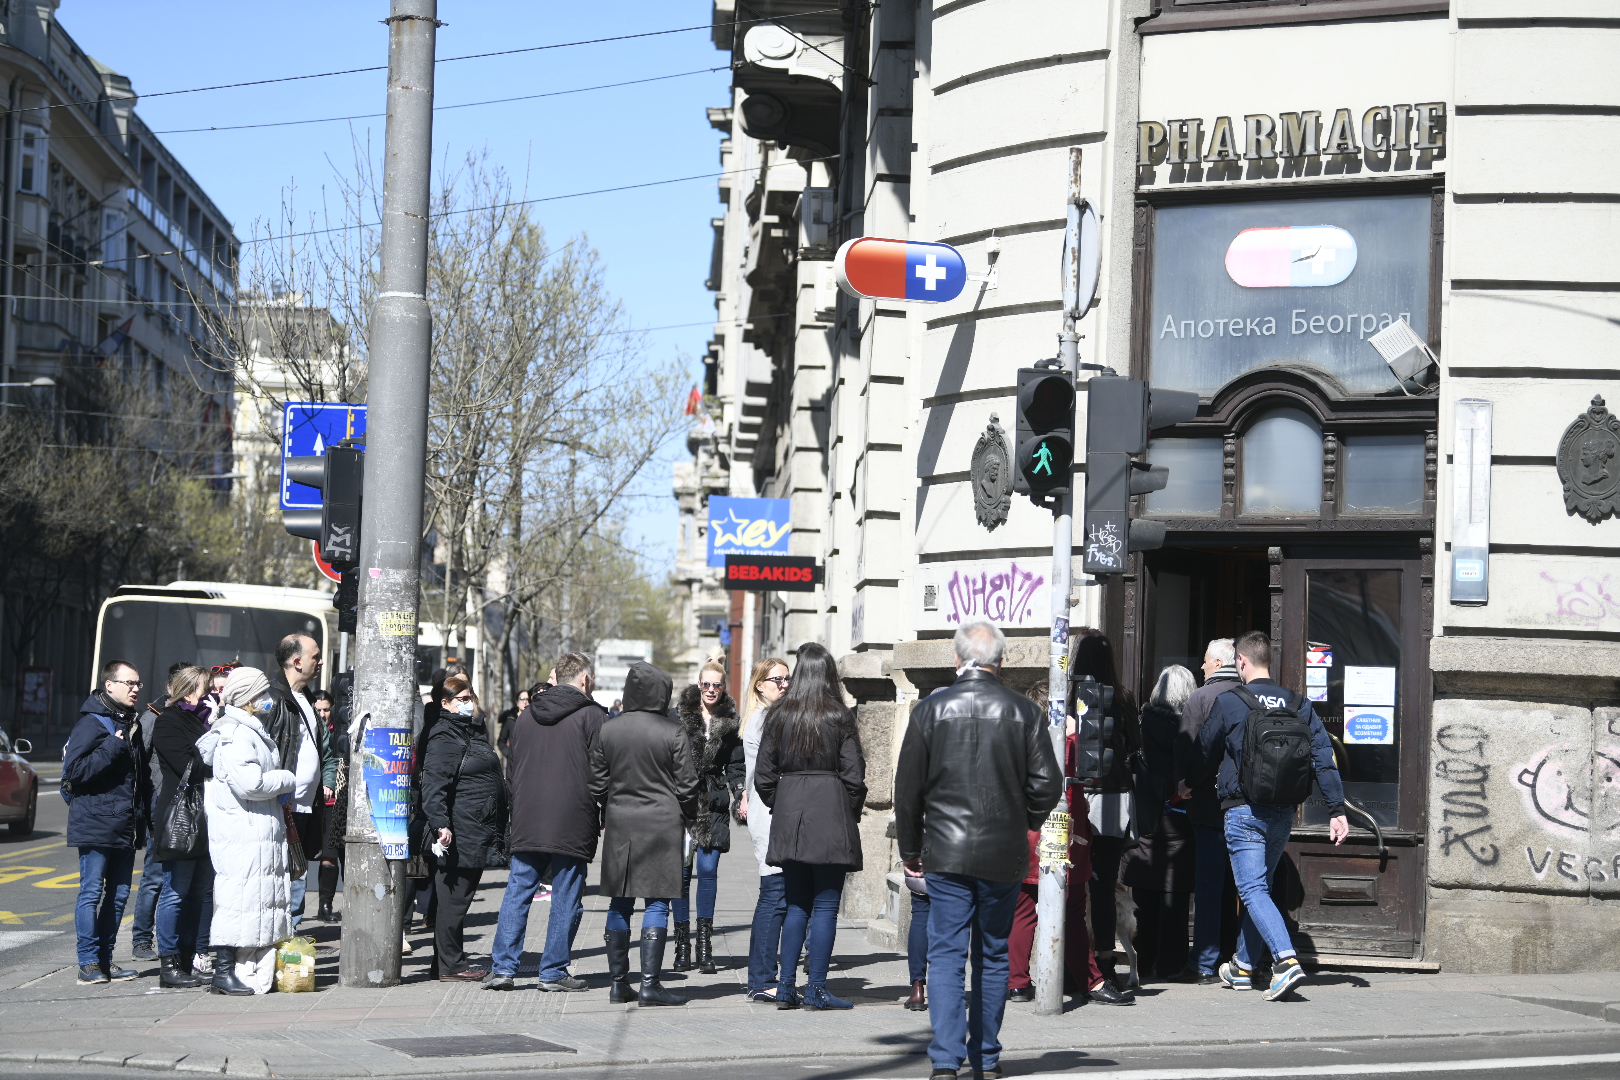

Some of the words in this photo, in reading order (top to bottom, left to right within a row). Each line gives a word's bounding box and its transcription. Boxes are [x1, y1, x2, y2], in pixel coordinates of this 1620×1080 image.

[1137, 102, 1446, 166] PHARMACIE
[1160, 314, 1276, 339] Апотека
[728, 564, 813, 582] BEBAKIDS
[205, 612, 222, 635] 31
[1255, 694, 1286, 709] ASA
[388, 732, 412, 746] TAJLA
